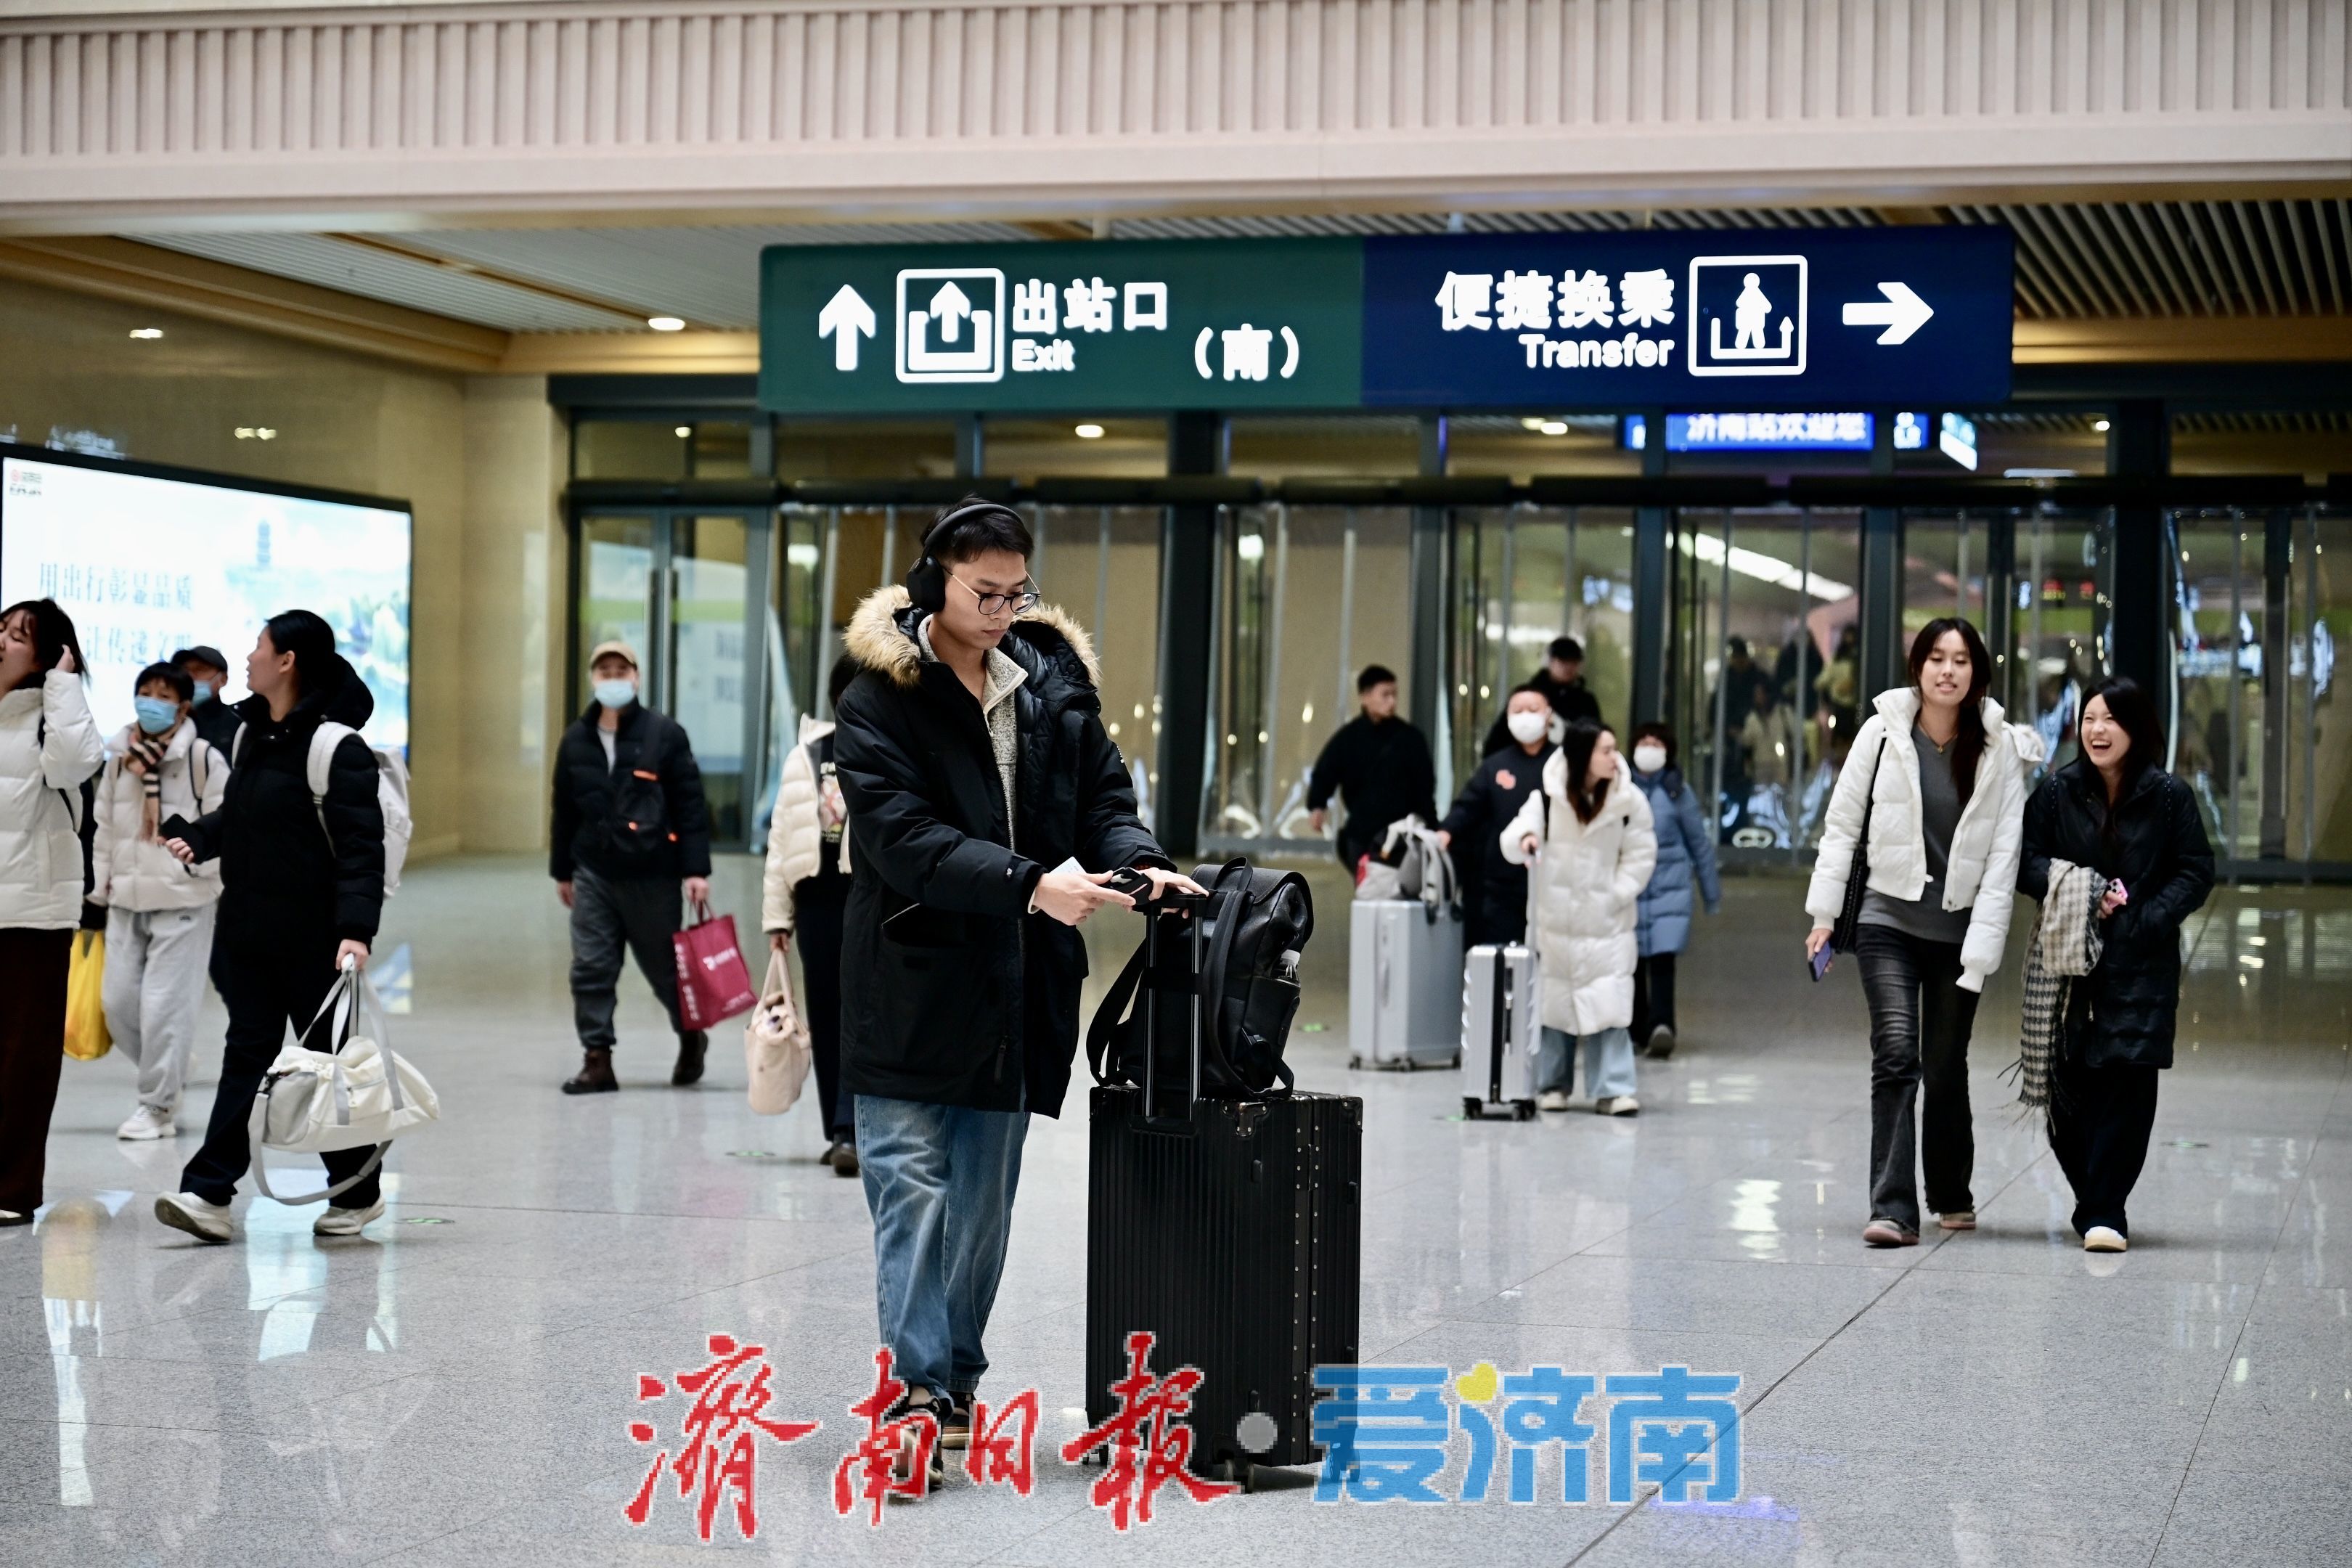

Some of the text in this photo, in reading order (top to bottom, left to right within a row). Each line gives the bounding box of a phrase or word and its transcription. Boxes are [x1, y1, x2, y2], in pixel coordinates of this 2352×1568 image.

[1011, 276, 1168, 335] 出站口
[1434, 267, 1675, 331] 便捷换乘
[1011, 338, 1076, 372] Exit
[1518, 332, 1675, 369] Transfer
